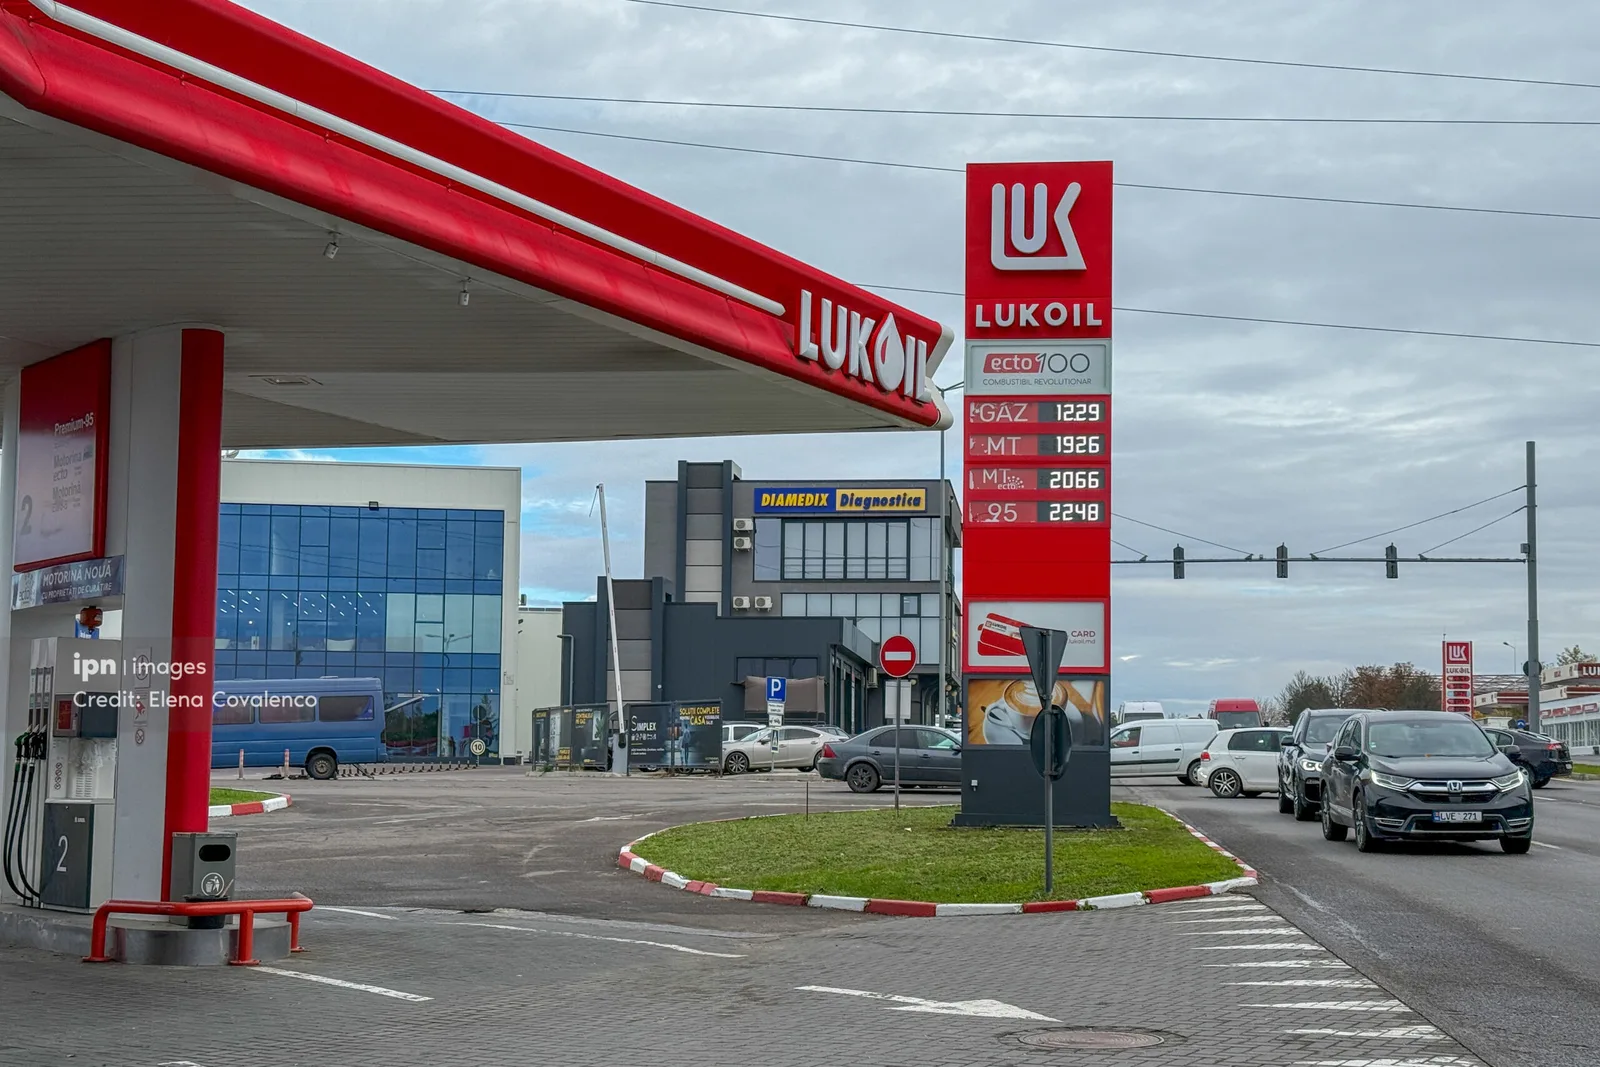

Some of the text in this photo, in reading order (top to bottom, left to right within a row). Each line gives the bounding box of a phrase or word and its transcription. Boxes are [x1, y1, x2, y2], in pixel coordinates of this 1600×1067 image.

[975, 303, 1102, 328] LUKOIL
[983, 378, 1032, 386] COMBUSTIBIL
[987, 436, 1099, 455] MT 1926
[983, 469, 1099, 489] MT 2066
[761, 492, 921, 510] DIAMEDIX Diagnostica
[19, 495, 33, 537] 2
[988, 503, 1098, 522] 95 2248
[1071, 630, 1096, 638] CARD
[1583, 666, 1600, 676] LU
[771, 679, 782, 697] P
[690, 715, 705, 726] CASA
[1441, 812, 1456, 821] LVE
[1463, 812, 1477, 821] 271
[56, 835, 69, 872] 2
